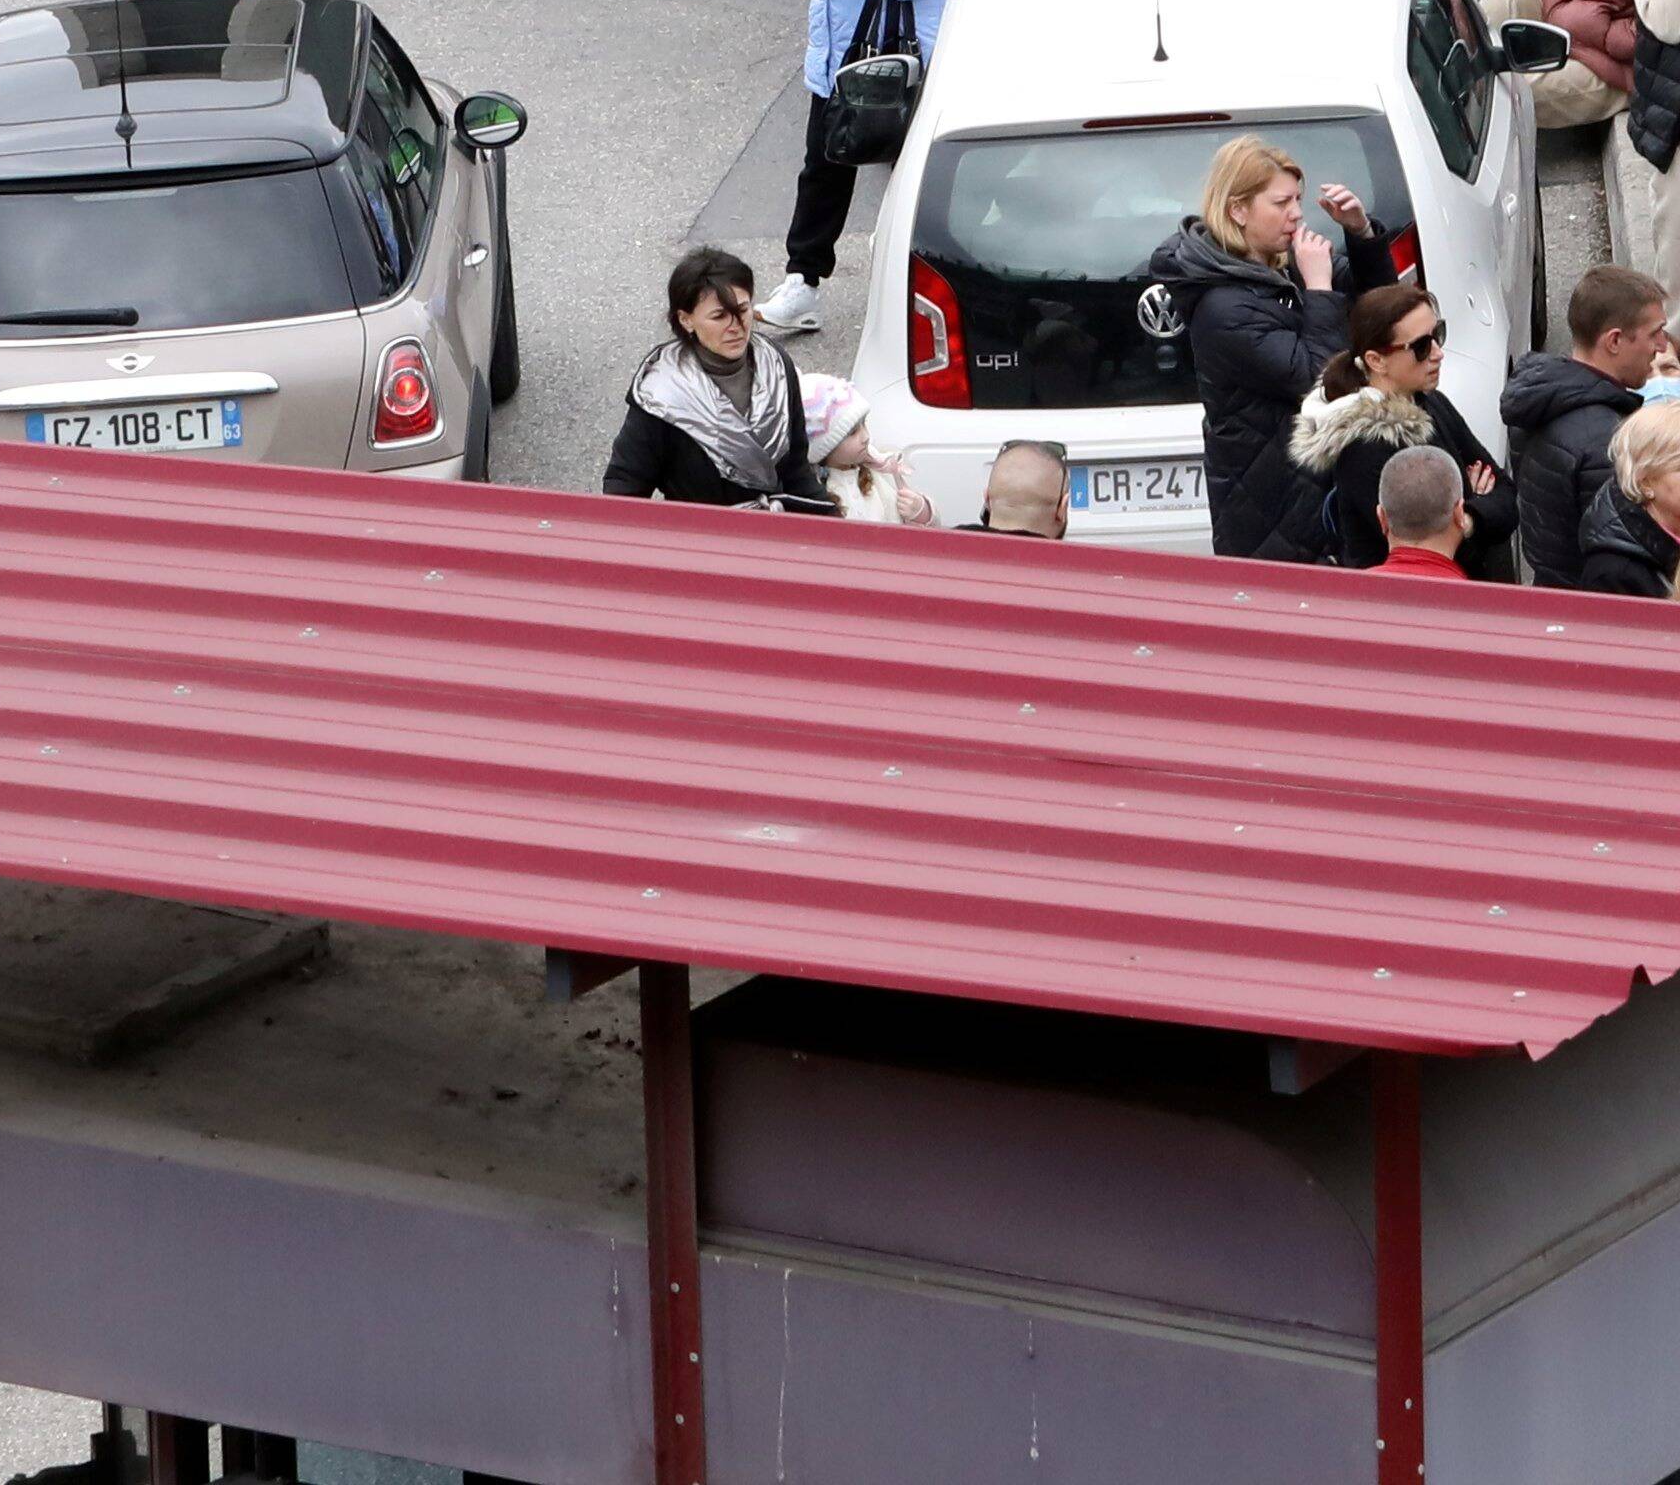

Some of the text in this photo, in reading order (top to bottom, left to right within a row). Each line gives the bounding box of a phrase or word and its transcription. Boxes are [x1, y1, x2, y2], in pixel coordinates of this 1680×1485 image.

[976, 350, 1020, 371] up!
[53, 407, 242, 449] CZ-108-CT 63
